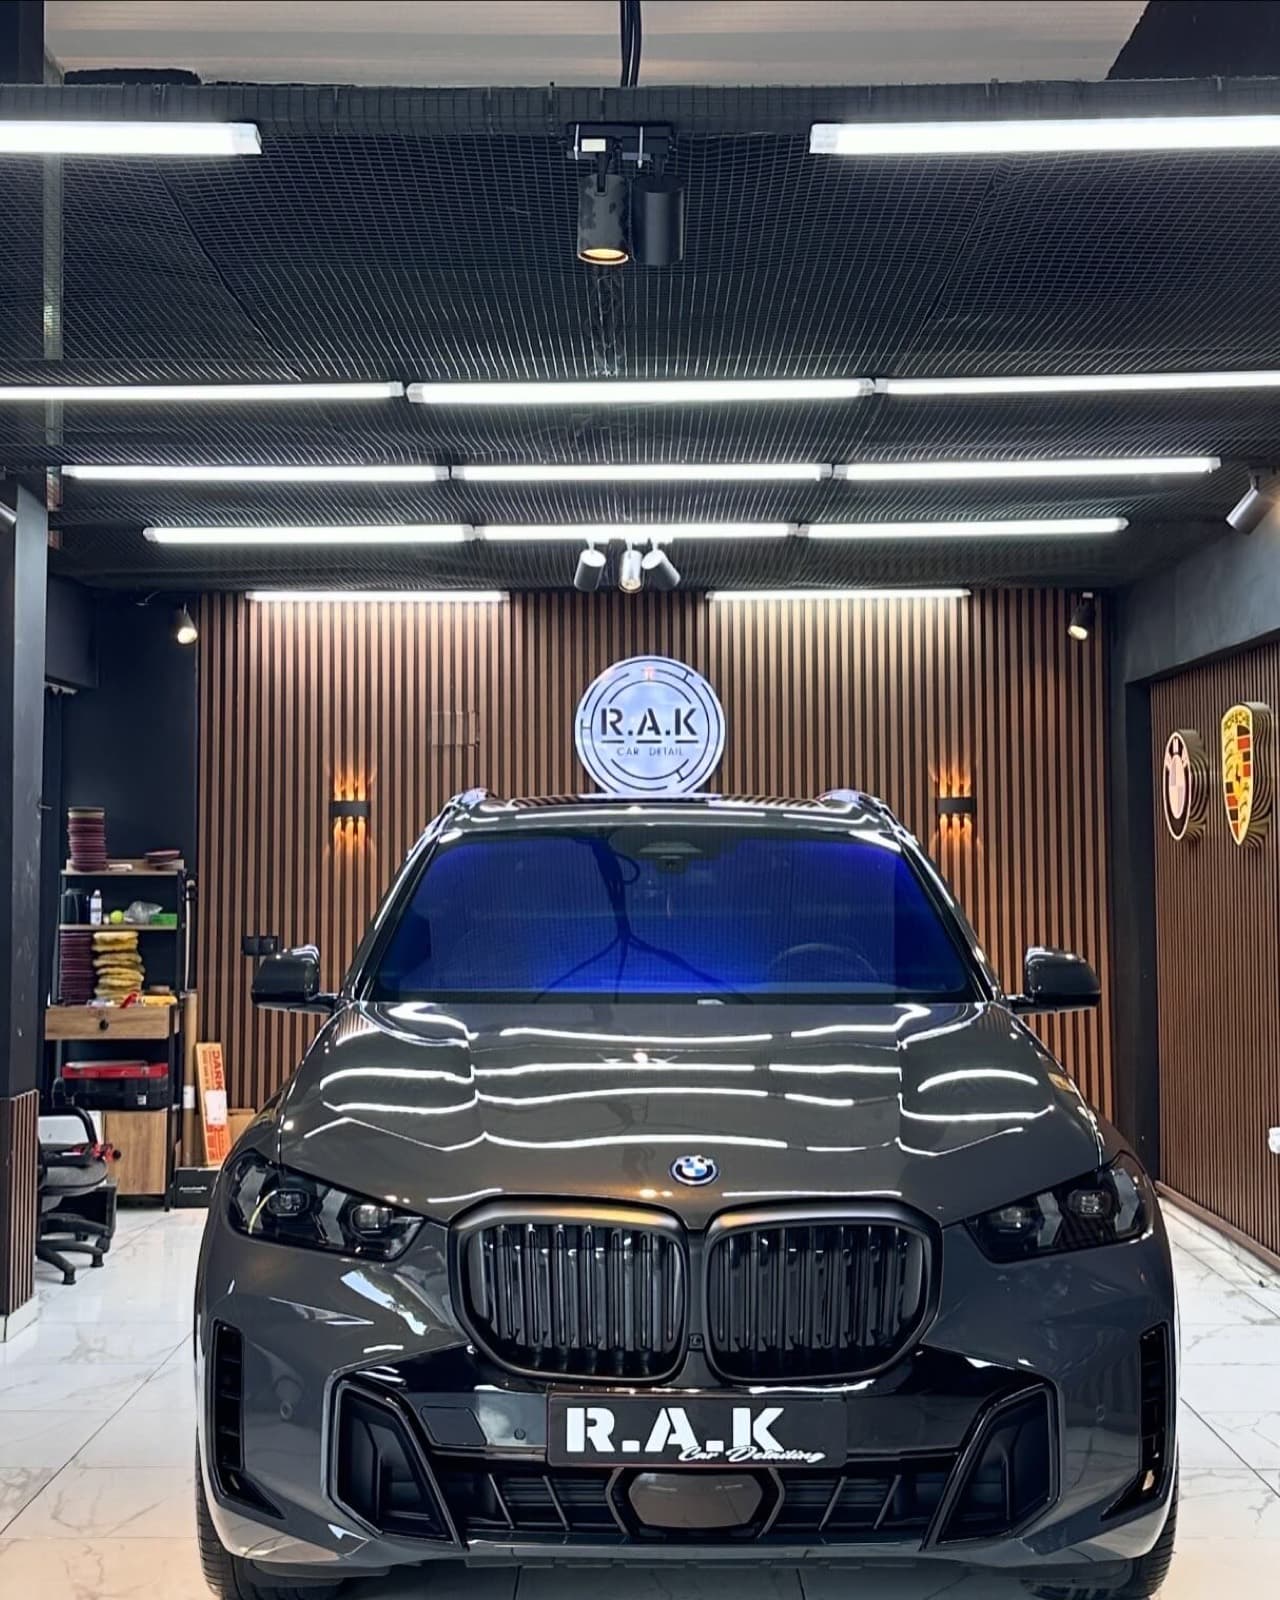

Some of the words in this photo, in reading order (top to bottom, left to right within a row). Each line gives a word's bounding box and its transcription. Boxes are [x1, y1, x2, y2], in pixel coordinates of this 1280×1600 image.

[600, 707, 698, 736] R.A.K
[616, 747, 640, 757] CAR
[649, 746, 684, 757] DETAIL
[566, 1407, 785, 1452] R.A.K
[678, 1446, 719, 1462] Car
[725, 1444, 826, 1463] Detailing
